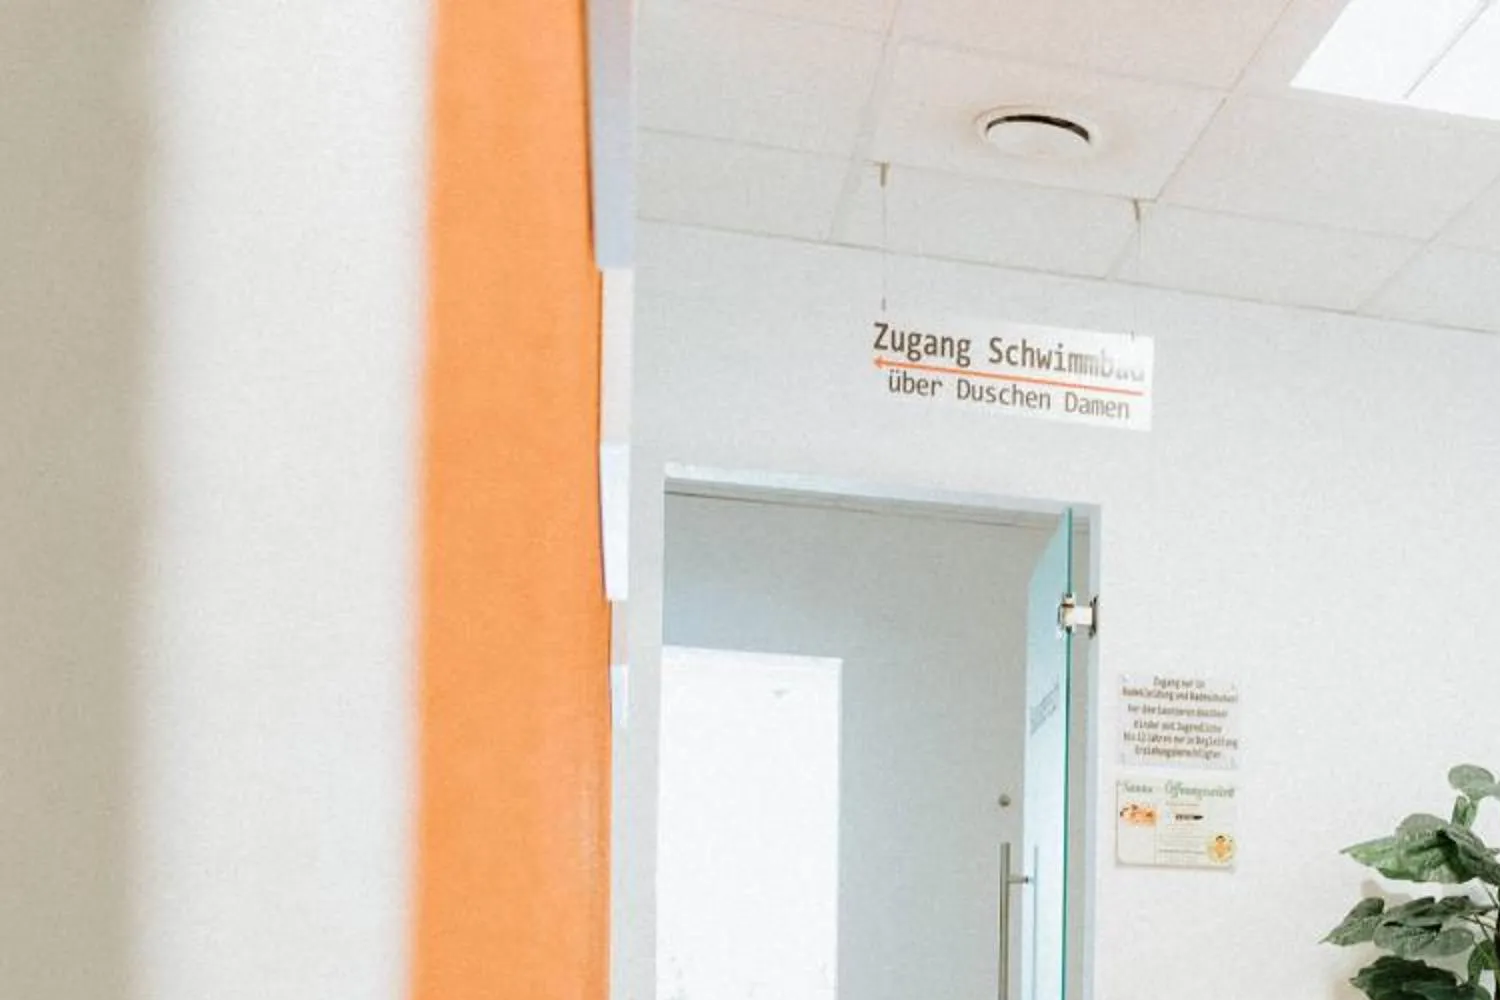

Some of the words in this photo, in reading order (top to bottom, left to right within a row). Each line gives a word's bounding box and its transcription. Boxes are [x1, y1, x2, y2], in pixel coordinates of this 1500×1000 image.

[873, 322, 971, 368] Zugang
[888, 369, 943, 397] über
[956, 378, 1051, 410] Duschen
[1064, 391, 1130, 420] Damen
